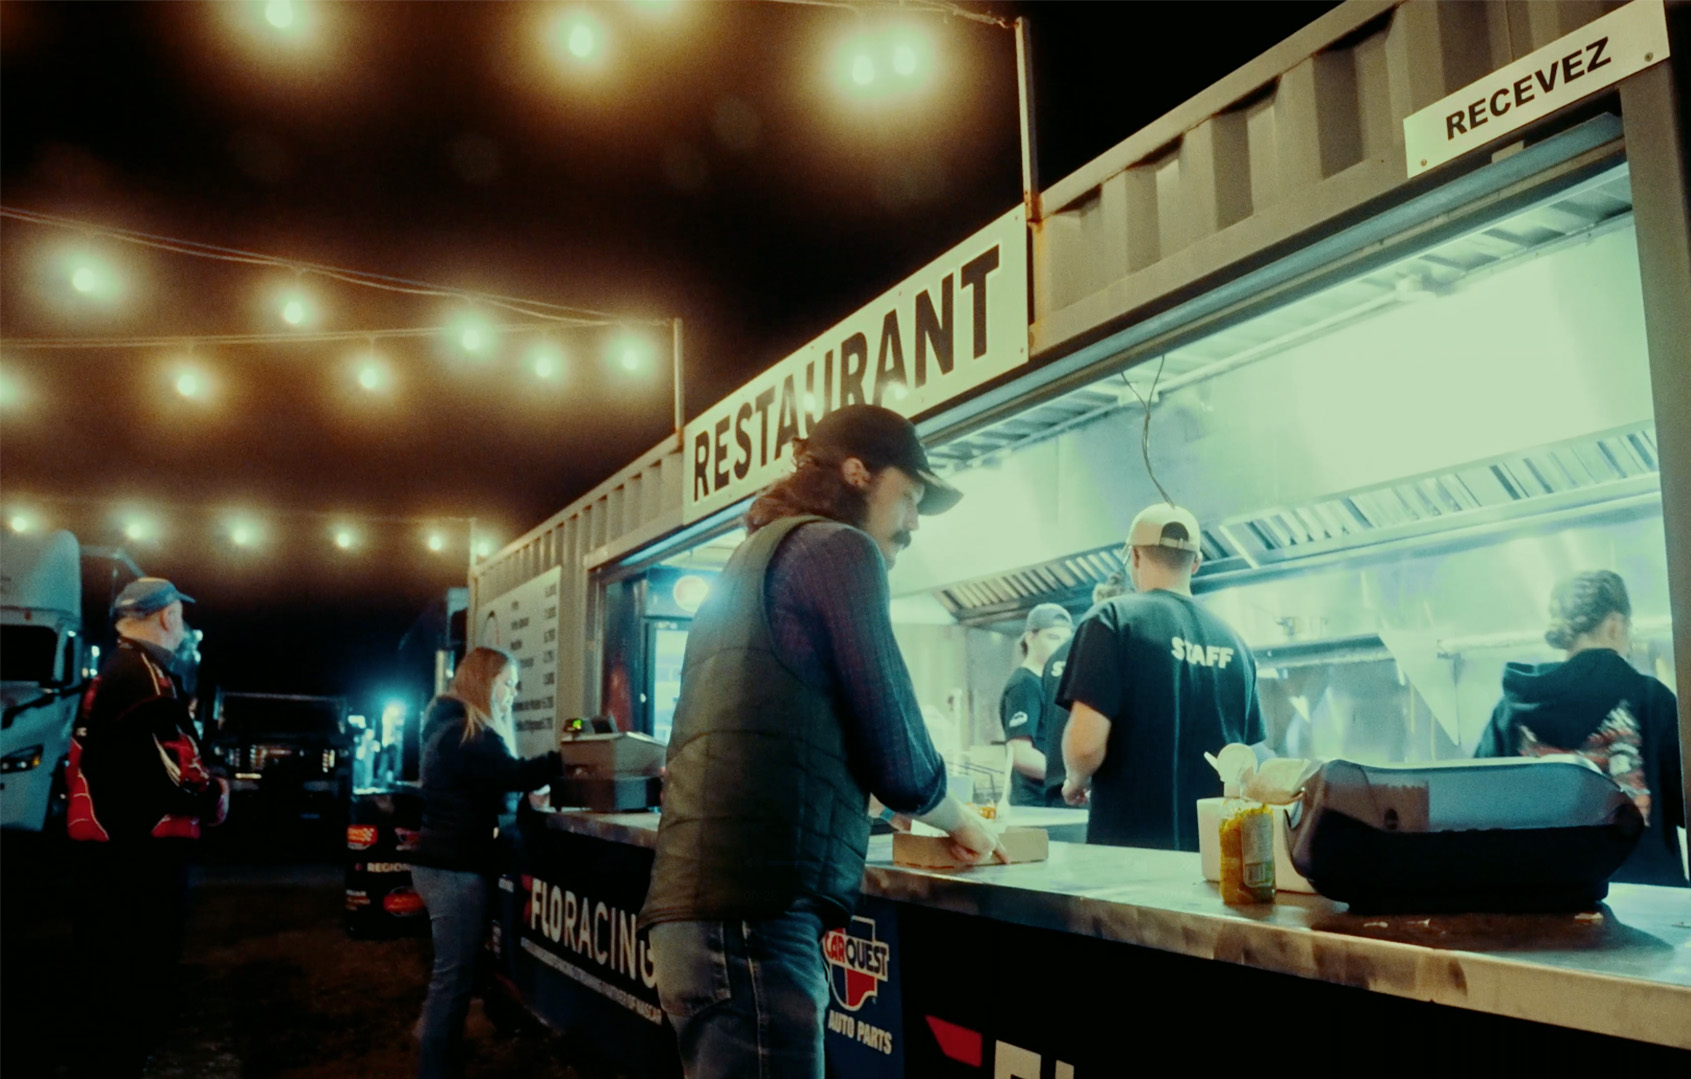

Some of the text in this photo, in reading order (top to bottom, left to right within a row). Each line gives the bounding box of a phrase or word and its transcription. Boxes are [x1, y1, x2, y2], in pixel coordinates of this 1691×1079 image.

[1446, 36, 1612, 141] RECEVEZ
[694, 243, 1000, 502] RESTAURANT
[1171, 636, 1234, 669] STAFF
[828, 1010, 892, 1055] AUTO PARTS
